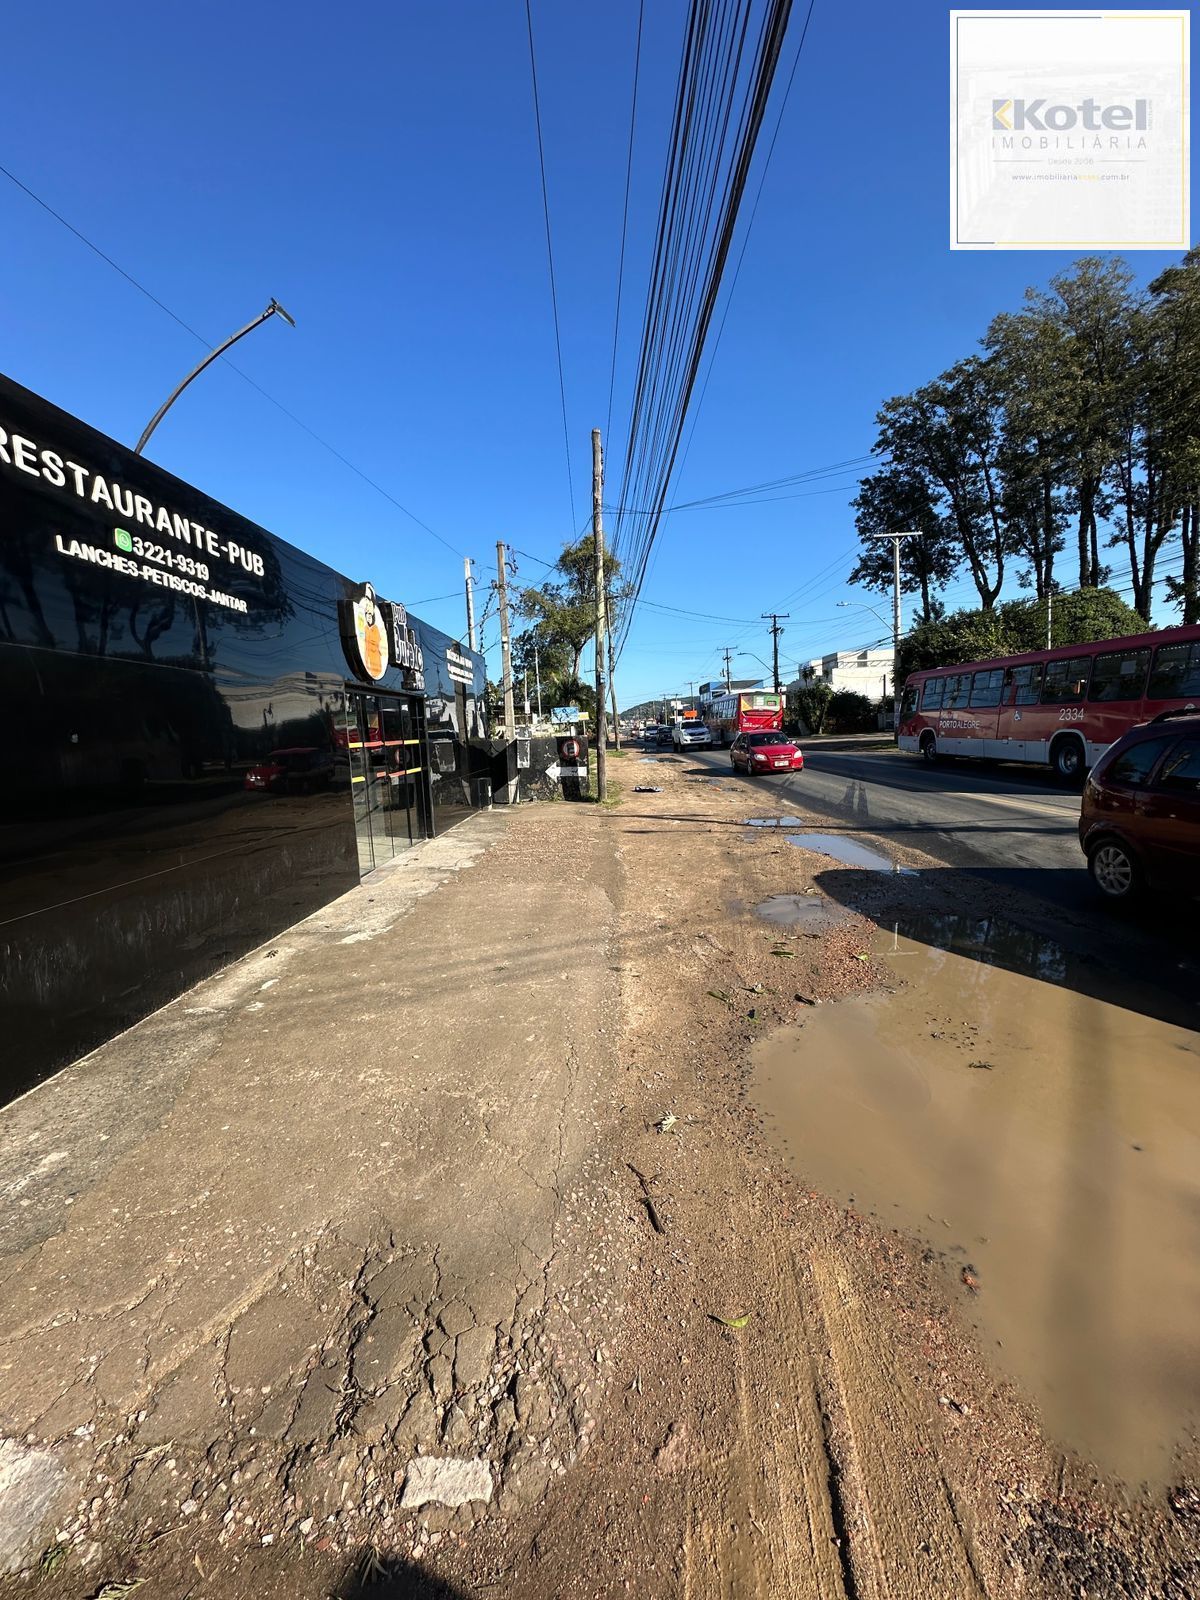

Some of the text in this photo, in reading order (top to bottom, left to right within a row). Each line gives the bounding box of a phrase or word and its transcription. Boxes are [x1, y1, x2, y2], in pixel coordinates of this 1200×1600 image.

[132, 535, 210, 581] 3221-9319
[55, 534, 249, 614] LANCHES-PETISCOS-JANTAR
[957, 720, 981, 730] ALEGRE
[1059, 707, 1085, 721] 2334
